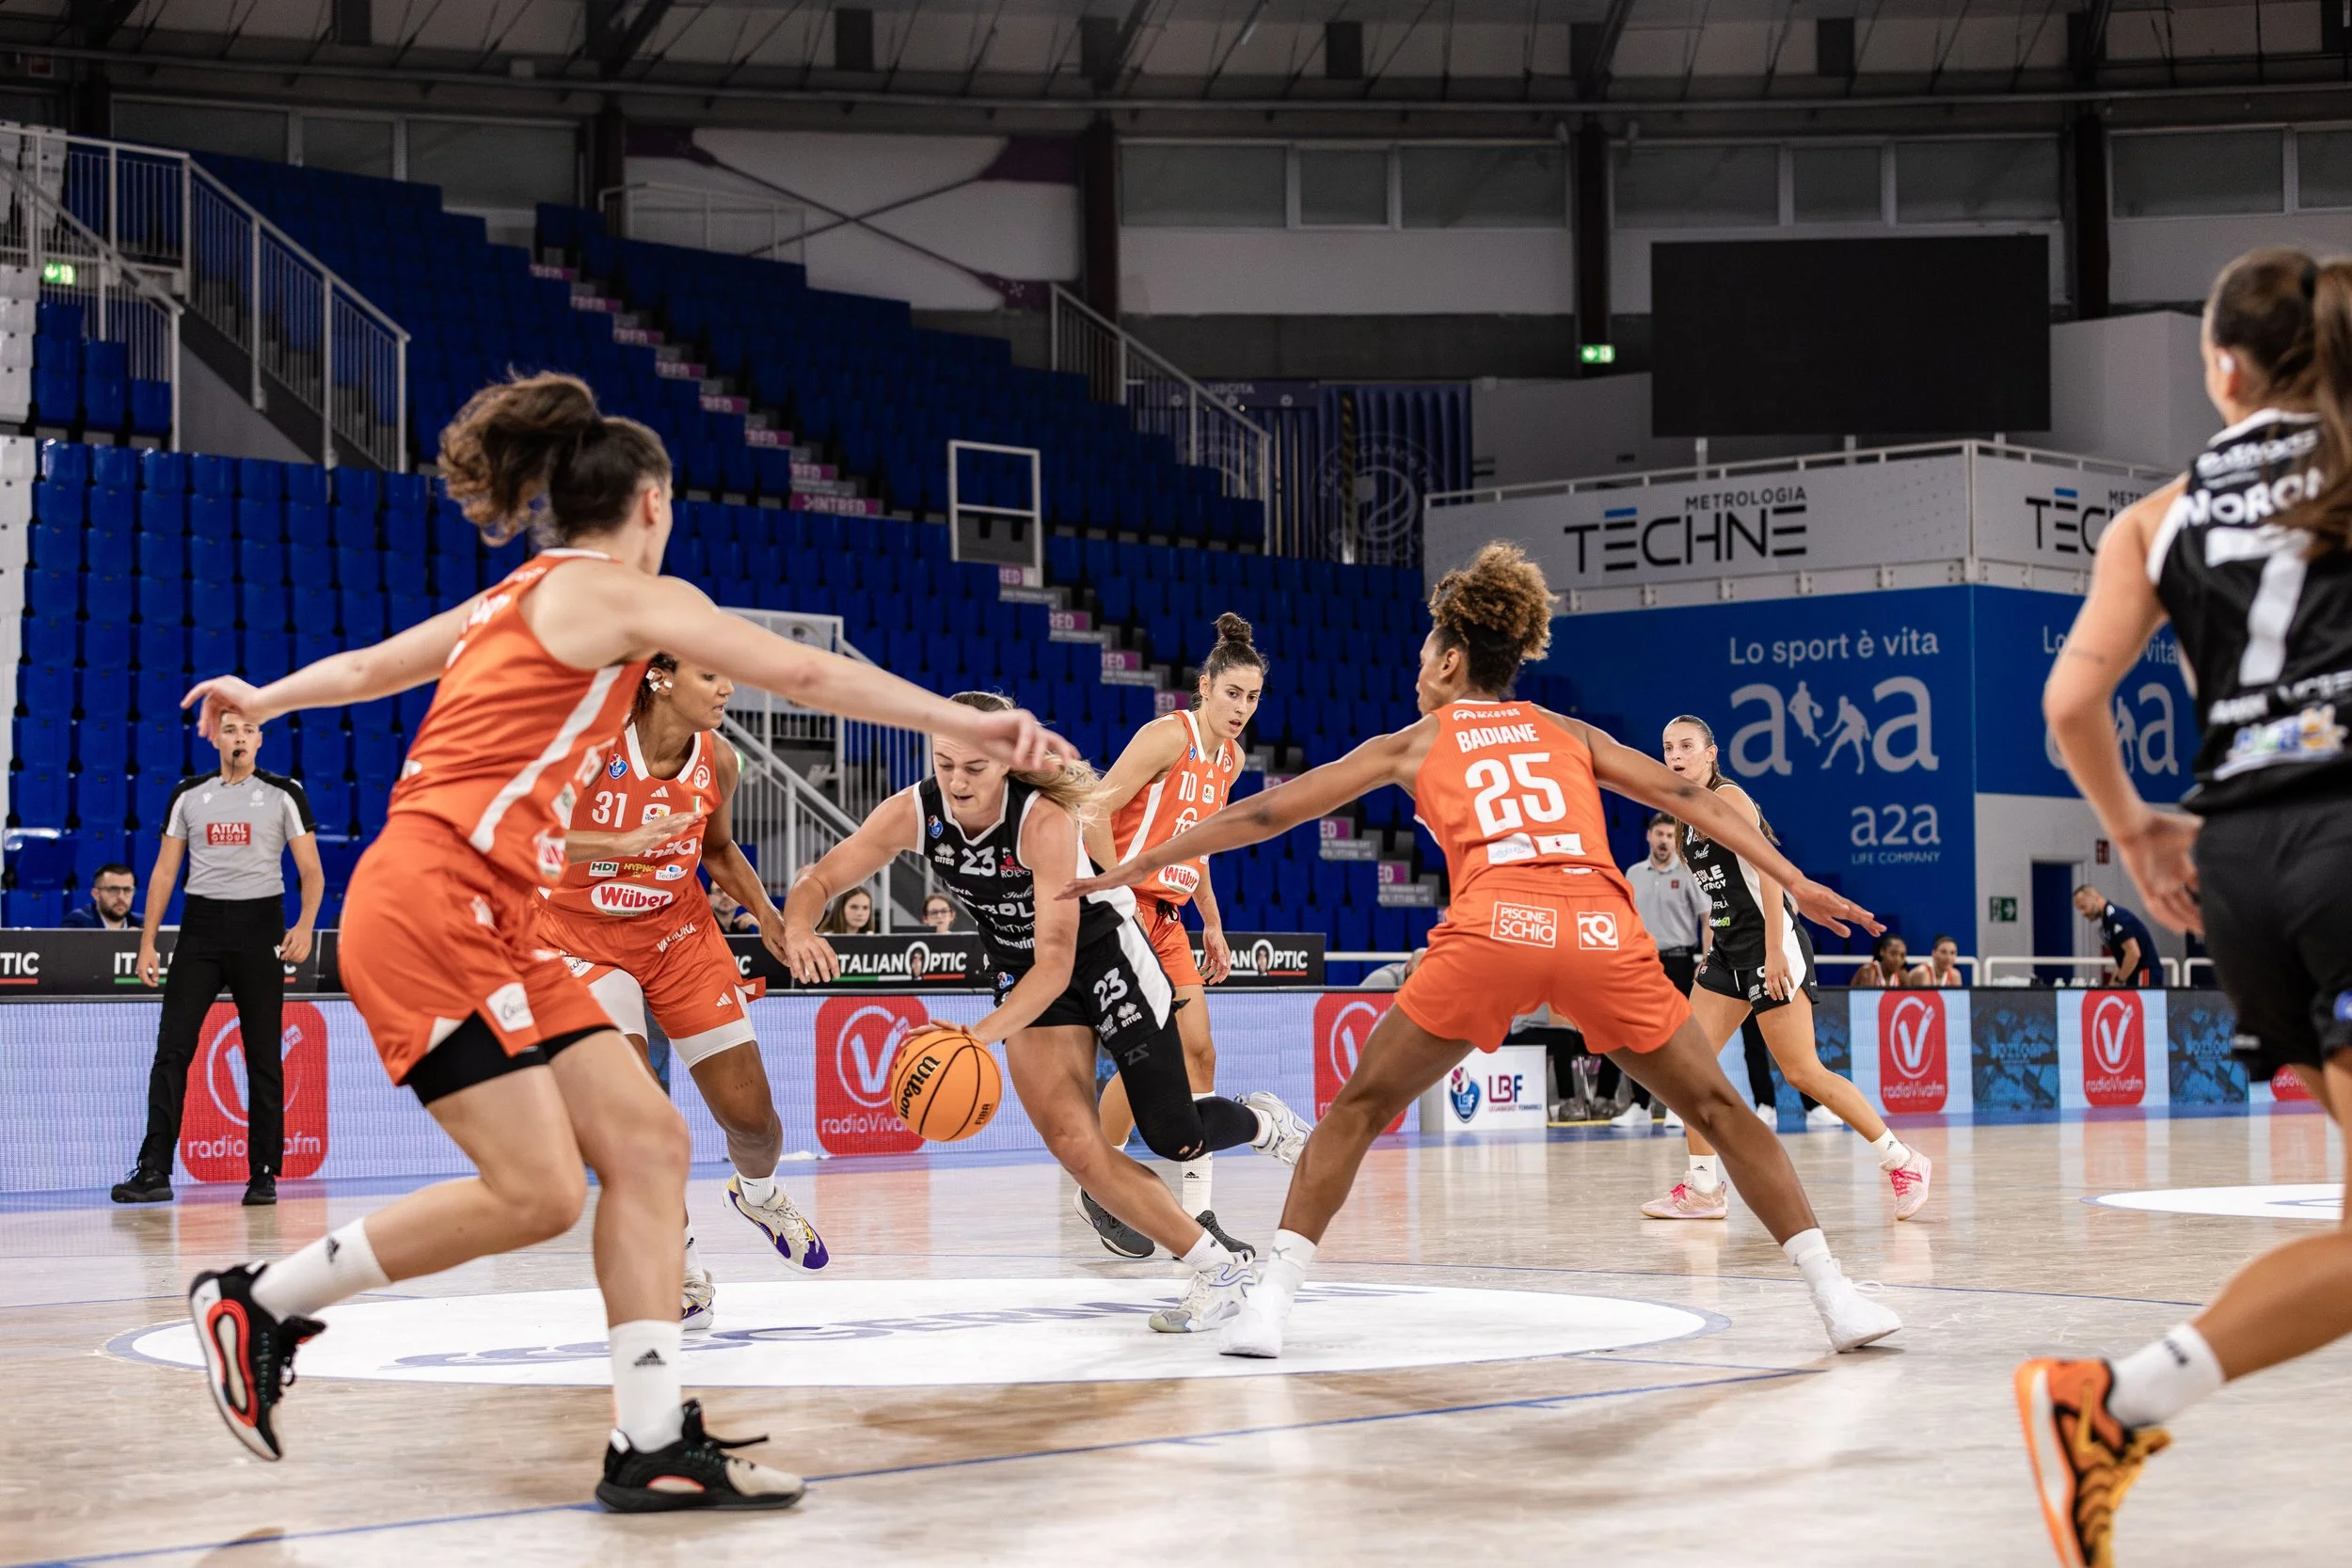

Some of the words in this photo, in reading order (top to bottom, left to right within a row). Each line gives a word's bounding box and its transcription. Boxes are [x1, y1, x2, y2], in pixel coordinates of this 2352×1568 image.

[1686, 486, 1806, 512] METROLOGIA
[2026, 487, 2115, 555] TEC
[1564, 505, 1807, 574] TECHNE
[2205, 524, 2313, 687] 7
[1729, 636, 1764, 665] Lo
[1772, 632, 1850, 669] sport
[1857, 628, 1875, 658] è
[1883, 626, 1940, 657] vita
[1454, 722, 1540, 753] BADIANE
[1178, 770, 1198, 802] 10
[1464, 752, 1567, 839] 25
[592, 790, 628, 829] 31
[1850, 803, 1941, 847] a2a
[211, 823, 247, 834] ATTAL
[211, 833, 247, 842] GROUP
[591, 863, 618, 872] HDI
[959, 845, 996, 877] 23
[1851, 852, 1875, 865] LIFE
[1878, 850, 1941, 863] COMPANY
[600, 885, 670, 909] Wüber
[1498, 918, 1555, 942] SCHIO
[1500, 906, 1547, 923] PISCINE
[1093, 967, 1128, 1012] 23
[900, 1055, 941, 1119] Wilson
[1488, 1075, 1523, 1103] LBF
[821, 1113, 908, 1135] radioViva
